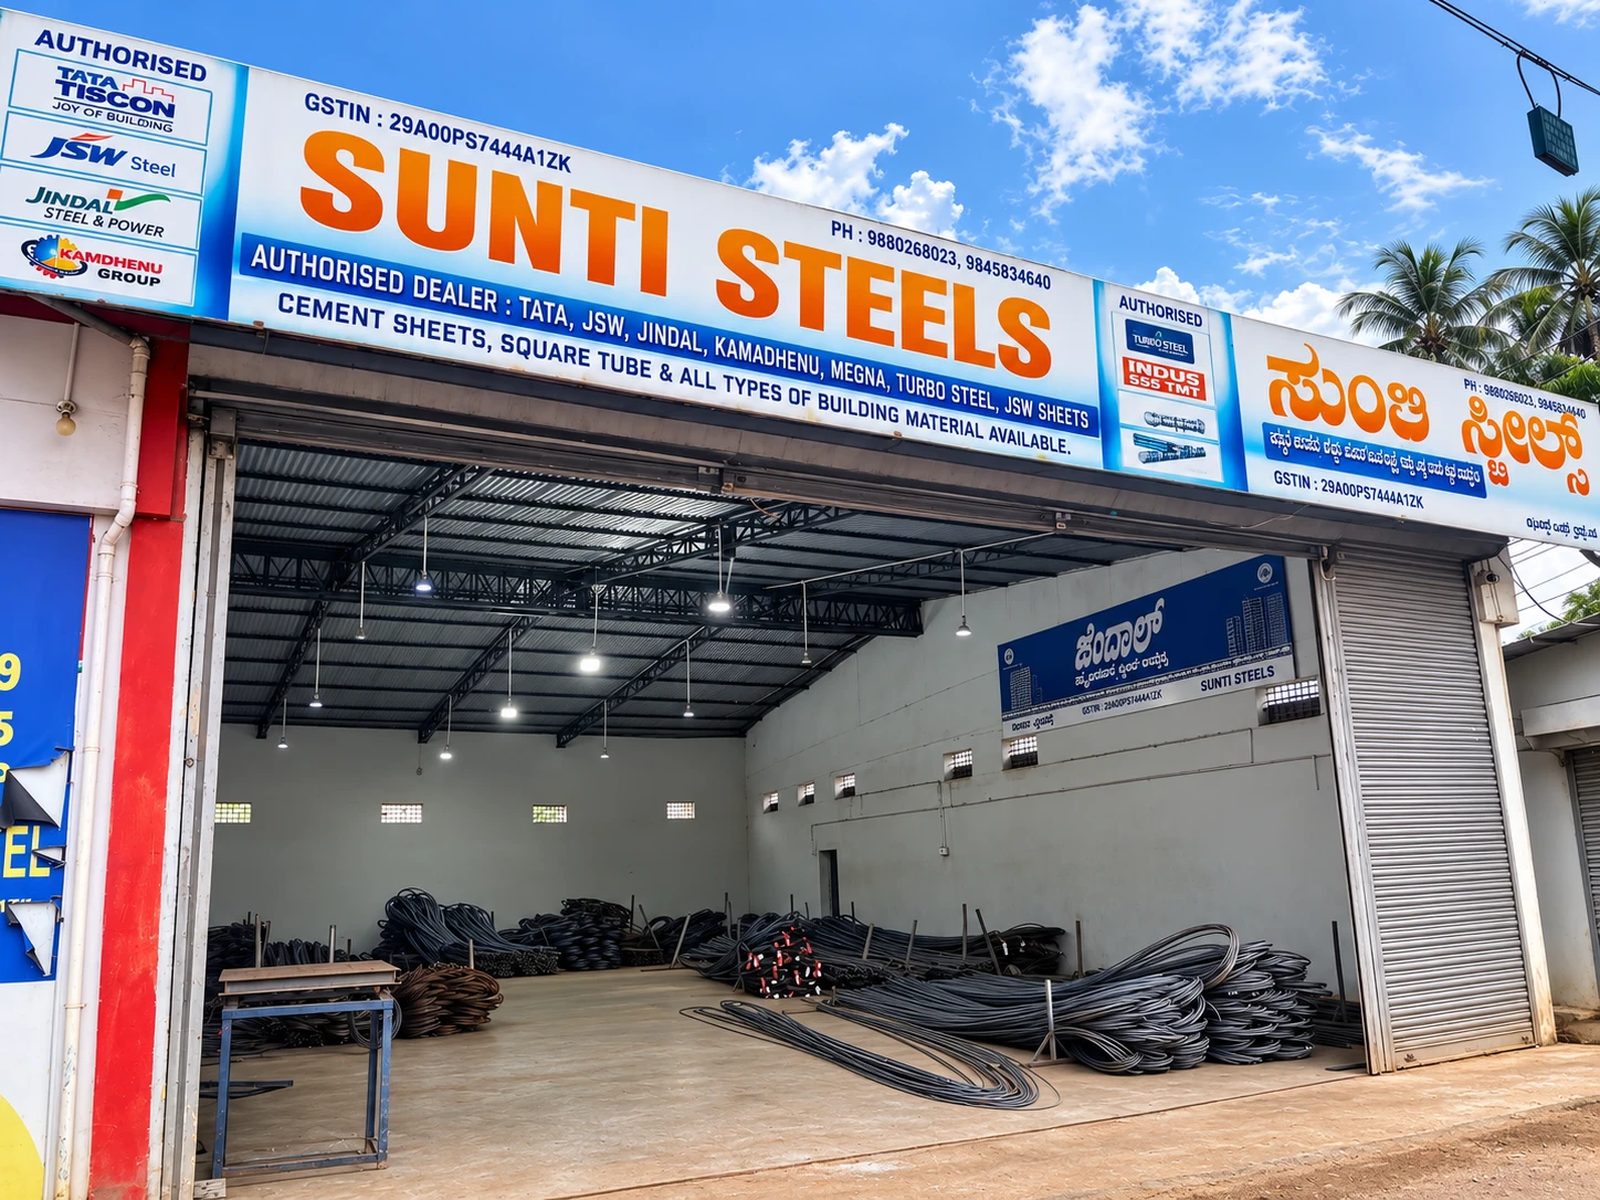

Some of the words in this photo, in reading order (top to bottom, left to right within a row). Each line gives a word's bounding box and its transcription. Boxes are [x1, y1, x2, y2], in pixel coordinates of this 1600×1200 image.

[34, 29, 207, 82] AUTHORISED
[57, 65, 118, 90] TATA
[52, 101, 79, 113] JOY
[84, 107, 103, 119] OF
[55, 79, 175, 118] TISCON
[305, 92, 371, 124] GSTIN
[30, 136, 128, 167] JSW
[130, 156, 176, 178] Steel
[26, 187, 113, 214] JINDAL
[44, 207, 89, 227] STEEL
[92, 215, 104, 228] &
[107, 218, 164, 238] POWER
[60, 248, 163, 274] KAMDHENU
[300, 130, 669, 297] SUNTI
[716, 228, 1052, 378] STEELS
[831, 220, 853, 240] PH
[867, 230, 961, 270] 9880268023,
[966, 255, 1051, 290] 9845834640
[98, 268, 161, 287] GROUP
[1119, 295, 1202, 327] AUTHORISED
[250, 243, 403, 295] AUTHORISED
[413, 277, 497, 314] DEALER
[519, 297, 575, 332] TATA,
[582, 310, 630, 342] JSW,
[637, 321, 708, 358] JINDAL,
[715, 336, 825, 380] KAMADHENU,
[831, 359, 891, 392] MEGNA,
[896, 373, 946, 401] TURBO
[951, 387, 1000, 415] STEEL,
[1004, 396, 1033, 418] JSW
[1038, 404, 1089, 429] SHEETS
[1163, 341, 1188, 354] STEEL
[278, 293, 385, 328] CEMENT
[393, 314, 492, 354] SHEETS,
[500, 333, 590, 367] SQUARE
[598, 351, 651, 379] TUBE
[660, 363, 673, 383] &
[680, 367, 716, 390] ALL
[723, 375, 782, 402] TYPES
[789, 387, 812, 406] OF
[818, 393, 899, 423] BUILDING
[905, 410, 984, 440] MATERIAL
[989, 427, 1071, 455] AVAILABLE.
[1128, 360, 1200, 386] INDUS
[1464, 378, 1477, 392] PH
[1164, 381, 1200, 397] TMT
[1274, 470, 1311, 489] GSTIN
[1201, 674, 1232, 692] SUNTI
[1235, 665, 1275, 685] STEELS
